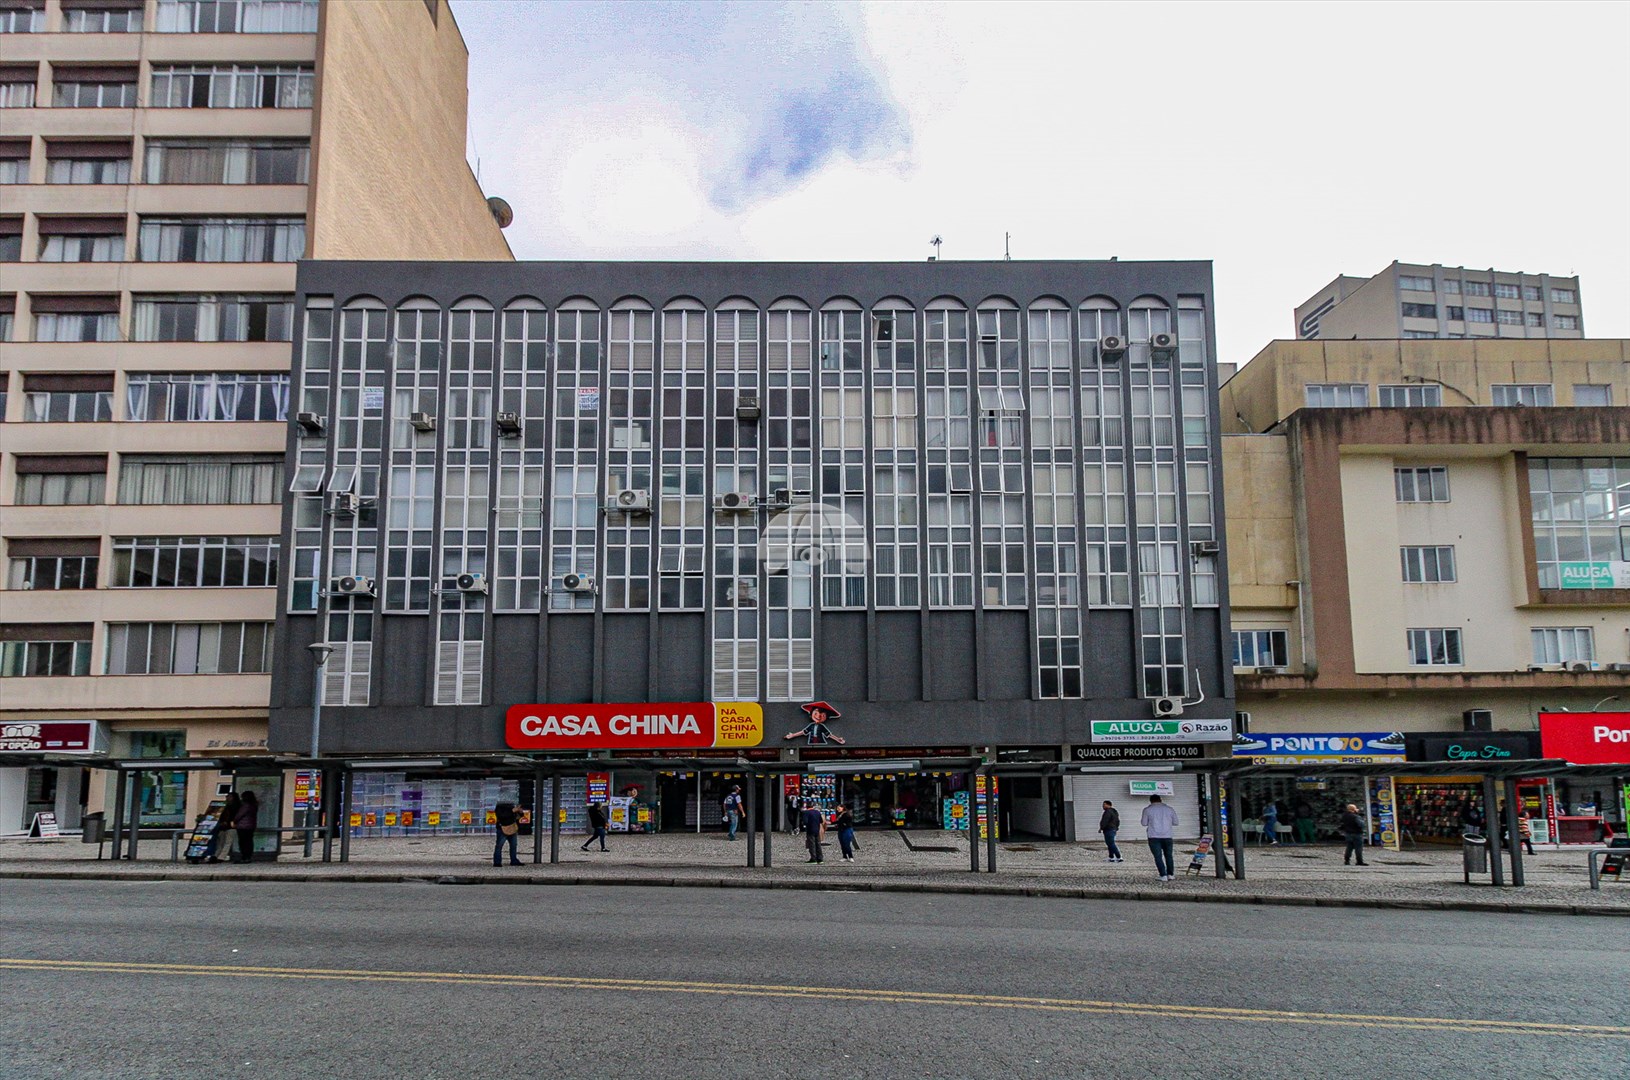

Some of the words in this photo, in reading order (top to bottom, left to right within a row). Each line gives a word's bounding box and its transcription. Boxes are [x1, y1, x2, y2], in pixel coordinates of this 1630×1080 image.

[1565, 566, 1610, 578] ALUGA
[520, 715, 601, 736] CASA
[608, 714, 700, 735] CHINA
[1108, 722, 1164, 733] ALUGA
[1196, 724, 1228, 732] Razão
[1078, 748, 1122, 759] QUALQUER
[1124, 748, 1164, 757] PRODUTO
[1448, 745, 1477, 760] Capa
